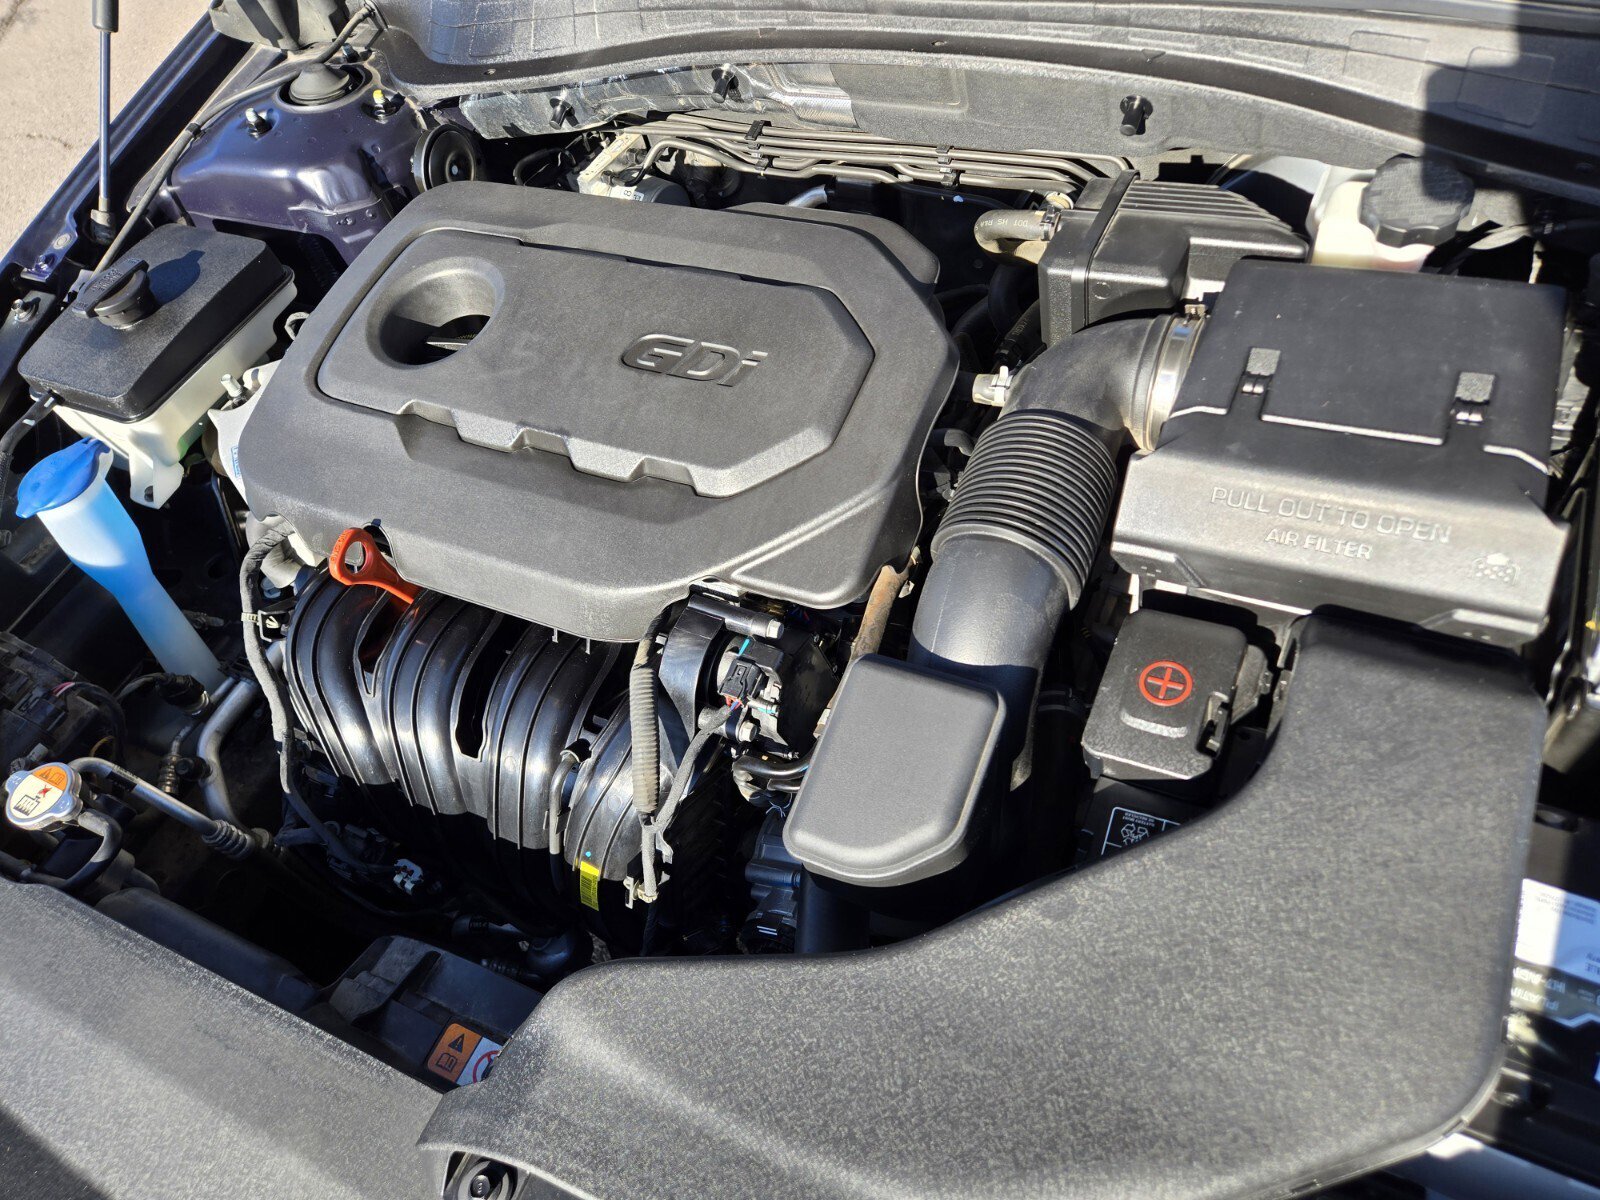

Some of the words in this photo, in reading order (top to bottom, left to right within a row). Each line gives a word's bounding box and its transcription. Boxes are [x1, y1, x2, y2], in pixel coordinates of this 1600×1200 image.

[1210, 486, 1271, 514] PULL
[1278, 498, 1330, 524] OUT
[1337, 505, 1370, 530] TO
[1376, 514, 1452, 544] OPEN
[1265, 527, 1299, 547] AIR
[1303, 536, 1374, 561] FILTER
